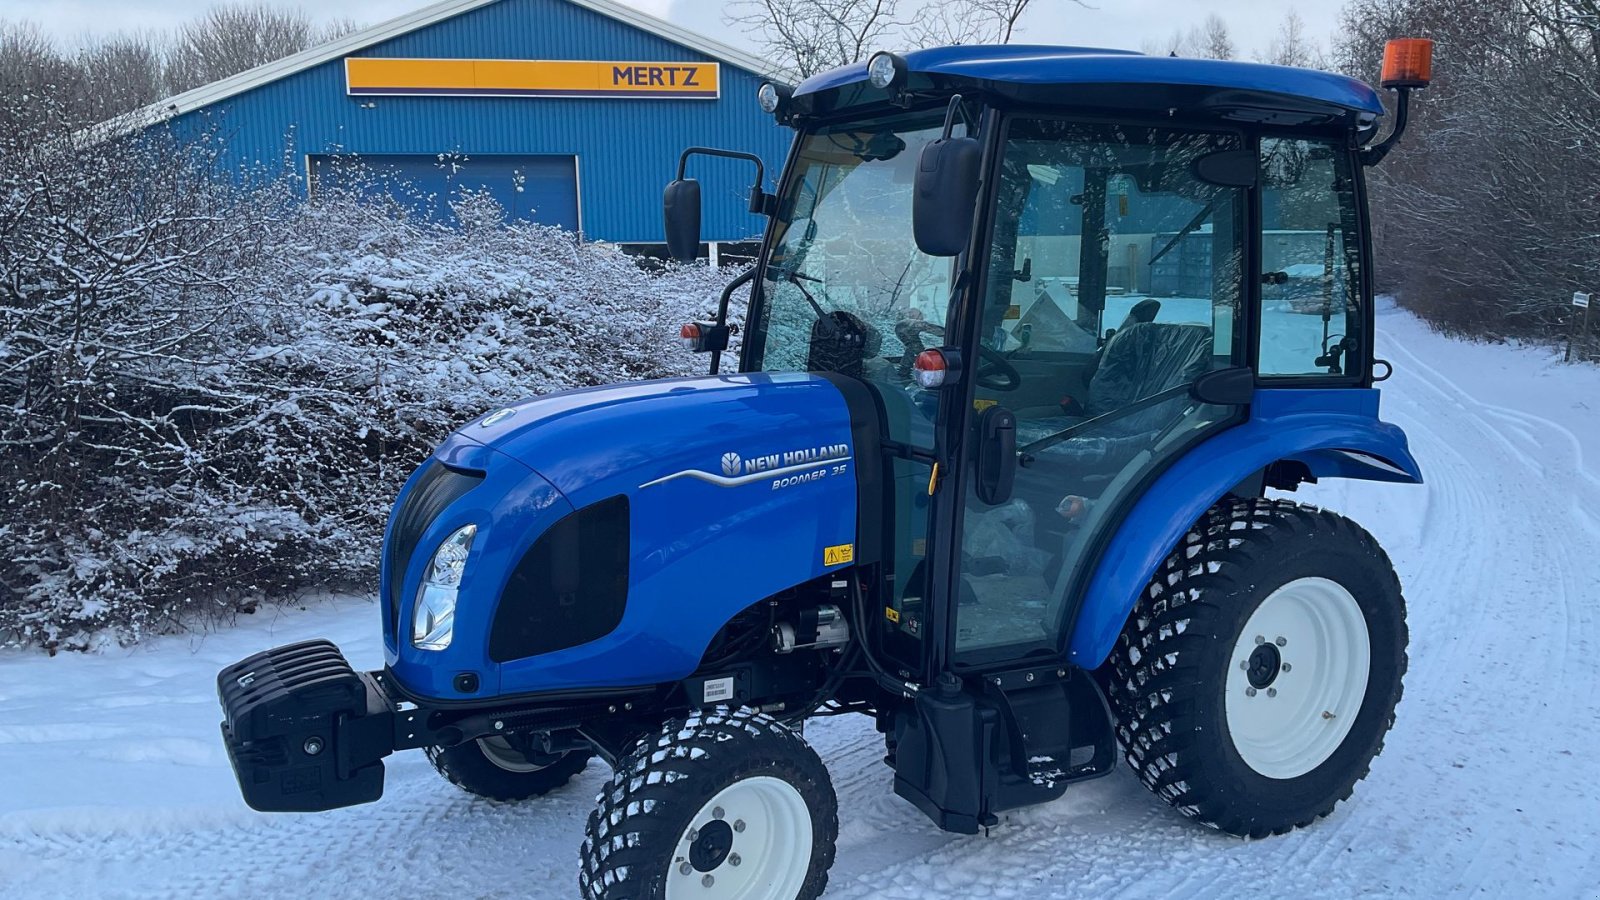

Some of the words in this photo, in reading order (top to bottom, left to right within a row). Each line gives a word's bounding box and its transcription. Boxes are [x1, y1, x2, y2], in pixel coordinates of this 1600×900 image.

[613, 66, 699, 86] MERTZ
[745, 454, 779, 473] NEW
[783, 444, 849, 465] HOLLAND
[771, 469, 827, 490] BOOMER
[831, 464, 847, 476] 35
